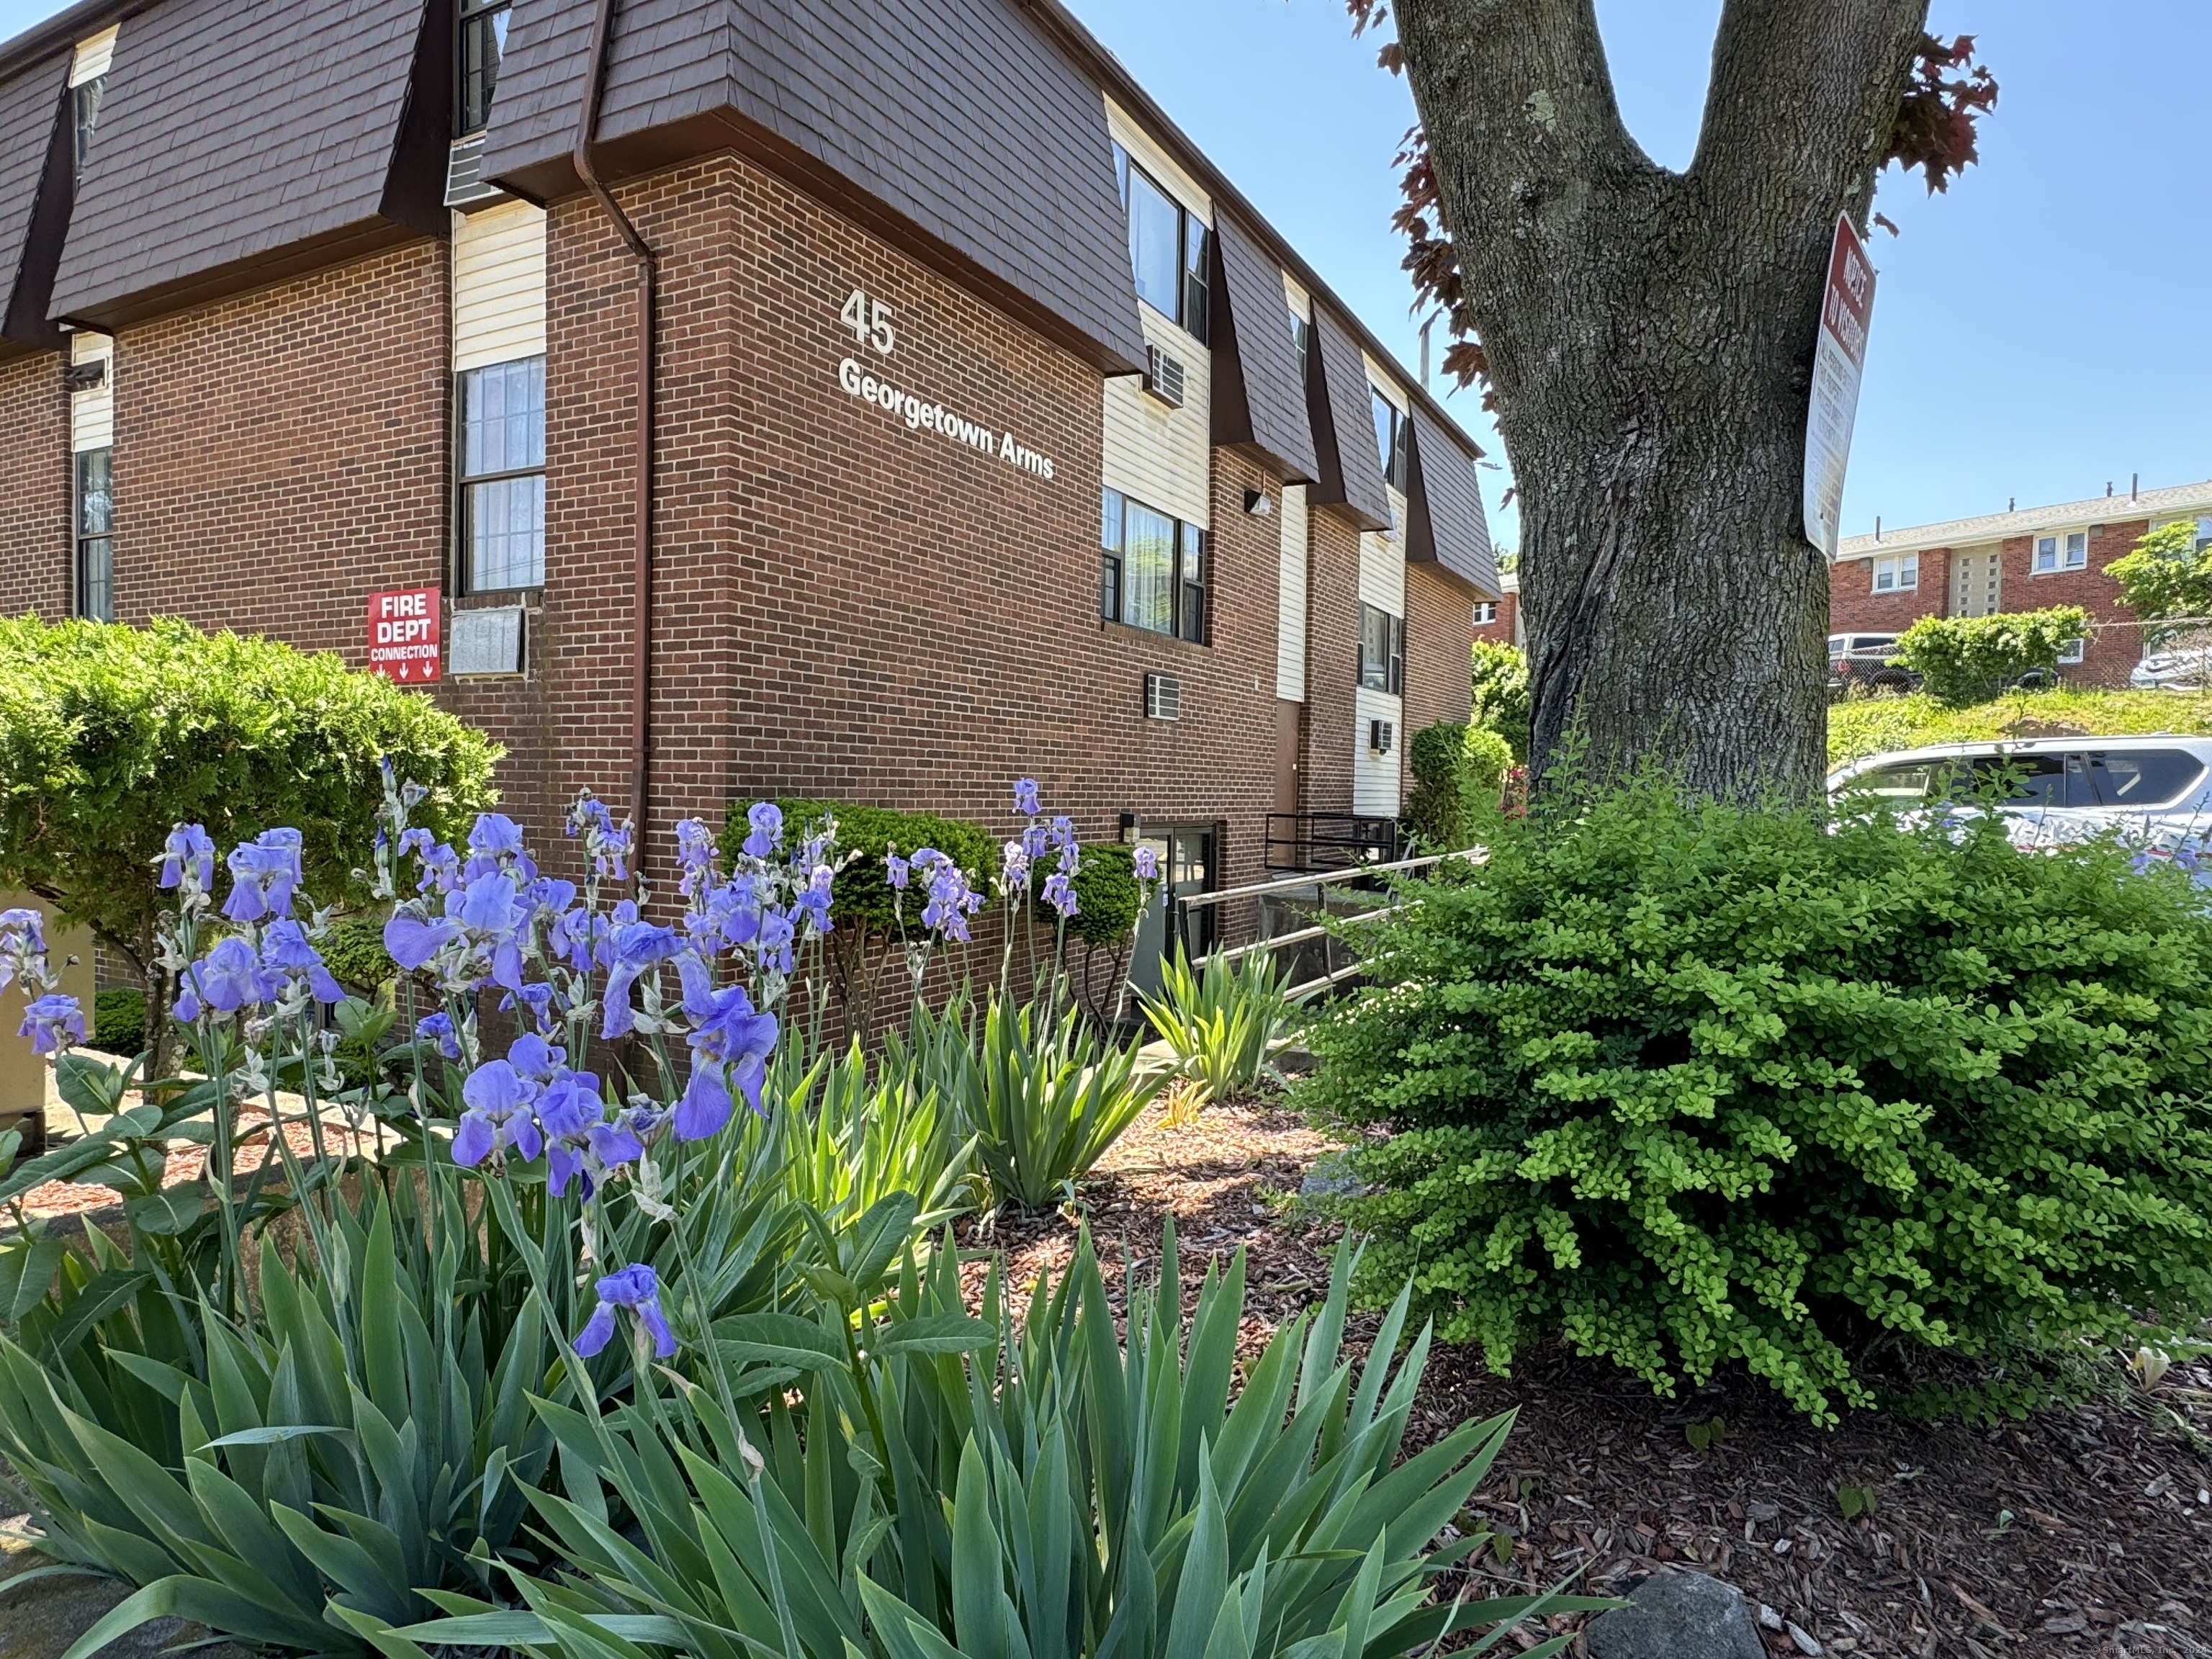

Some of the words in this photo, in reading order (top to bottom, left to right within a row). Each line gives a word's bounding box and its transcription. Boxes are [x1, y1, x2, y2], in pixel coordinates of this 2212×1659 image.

[1843, 246, 1867, 310] NOTICE
[840, 289, 895, 355] 45
[1827, 283, 1840, 326] TO
[1837, 297, 1865, 364] VISITORS
[838, 358, 994, 455] Georgetown
[999, 431, 1054, 480] Arms
[377, 619, 431, 644] DEPT
[381, 593, 427, 619] FIRE
[371, 644, 438, 662] CONNECTION
